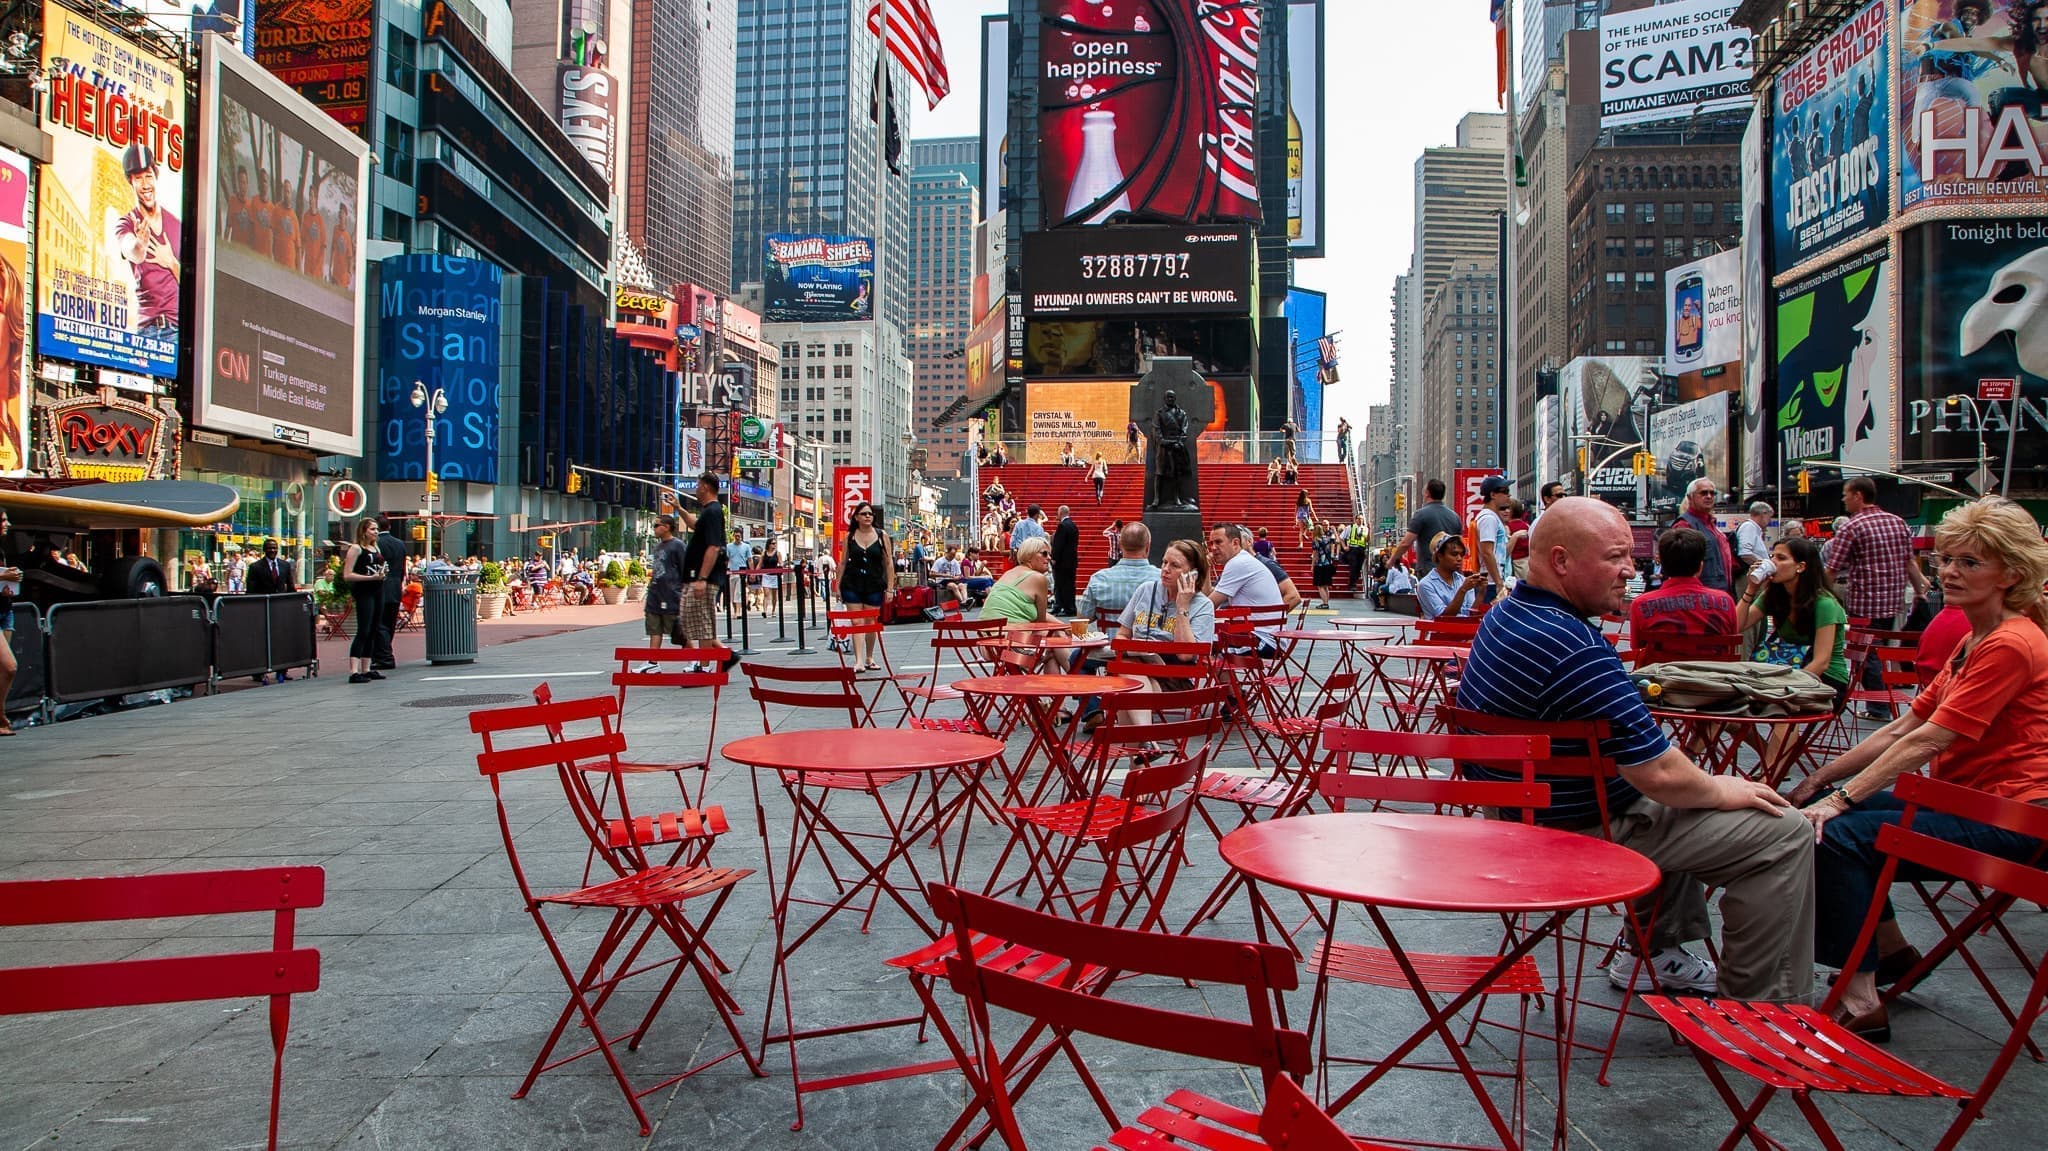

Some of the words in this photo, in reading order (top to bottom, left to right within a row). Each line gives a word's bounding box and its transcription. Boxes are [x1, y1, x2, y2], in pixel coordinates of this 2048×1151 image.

[256, 19, 372, 47] URRENCIES
[1607, 27, 1630, 39] THE
[1634, 15, 1690, 35] HUMANE
[1817, 1, 1884, 67] CROWD
[1073, 41, 1128, 59] open
[1604, 41, 1622, 53] OF
[1624, 36, 1648, 49] THE
[1652, 27, 1699, 44] UNITED
[67, 21, 81, 39] THE
[82, 30, 112, 55] HOTTEST
[114, 46, 133, 65] SHOW
[136, 55, 142, 70] IN
[144, 60, 158, 78] NEW
[160, 69, 175, 88] YORK
[93, 52, 110, 70] JUST
[113, 62, 126, 78] GOT
[258, 51, 292, 65] PRICE
[1604, 38, 1750, 89] SCAM?
[92, 70, 126, 98] THE
[319, 81, 361, 100] -0.09
[1783, 67, 1827, 114] GOES
[50, 73, 184, 172] HEIGHTS
[1786, 158, 1837, 231] JERSEY
[1840, 134, 1879, 203] BOYS
[1904, 187, 1921, 206] BEST
[1923, 182, 1983, 198] MUSICAL
[1987, 181, 2041, 195] REVIVAL
[1800, 220, 1822, 239] BEST
[1824, 200, 1864, 228] MUSICAL
[1812, 233, 1824, 246] TONY
[1844, 211, 1865, 229] WINNER
[1200, 235, 1238, 243] HYUNDAI
[1947, 223, 2013, 244] Tonight
[780, 242, 823, 258] BANANA
[826, 244, 868, 261] SHPEEL
[1034, 293, 1083, 307] HYUNDAI
[1086, 292, 1134, 305] OWNERS
[1136, 291, 1171, 304] CAN'T
[1173, 291, 1188, 303] BE
[1190, 290, 1238, 303] WRONG.
[1708, 284, 1733, 299] When
[53, 290, 96, 322] CORBIN
[101, 303, 128, 330] BLEU
[418, 306, 455, 318] Morgan
[456, 307, 487, 323] Stanley
[1708, 299, 1725, 314] Dad
[1708, 317, 1724, 331] you
[217, 347, 250, 384] CNN
[263, 364, 288, 385] Turkey
[289, 375, 318, 393] emerges
[319, 385, 327, 394] as
[263, 383, 287, 402] Middle
[288, 391, 304, 406] East
[305, 395, 326, 411] leader
[1033, 421, 1060, 429] OWINGS
[1061, 421, 1084, 430] MILLS,
[1679, 408, 1697, 421] Sonata
[1082, 430, 1113, 438] TOURING
